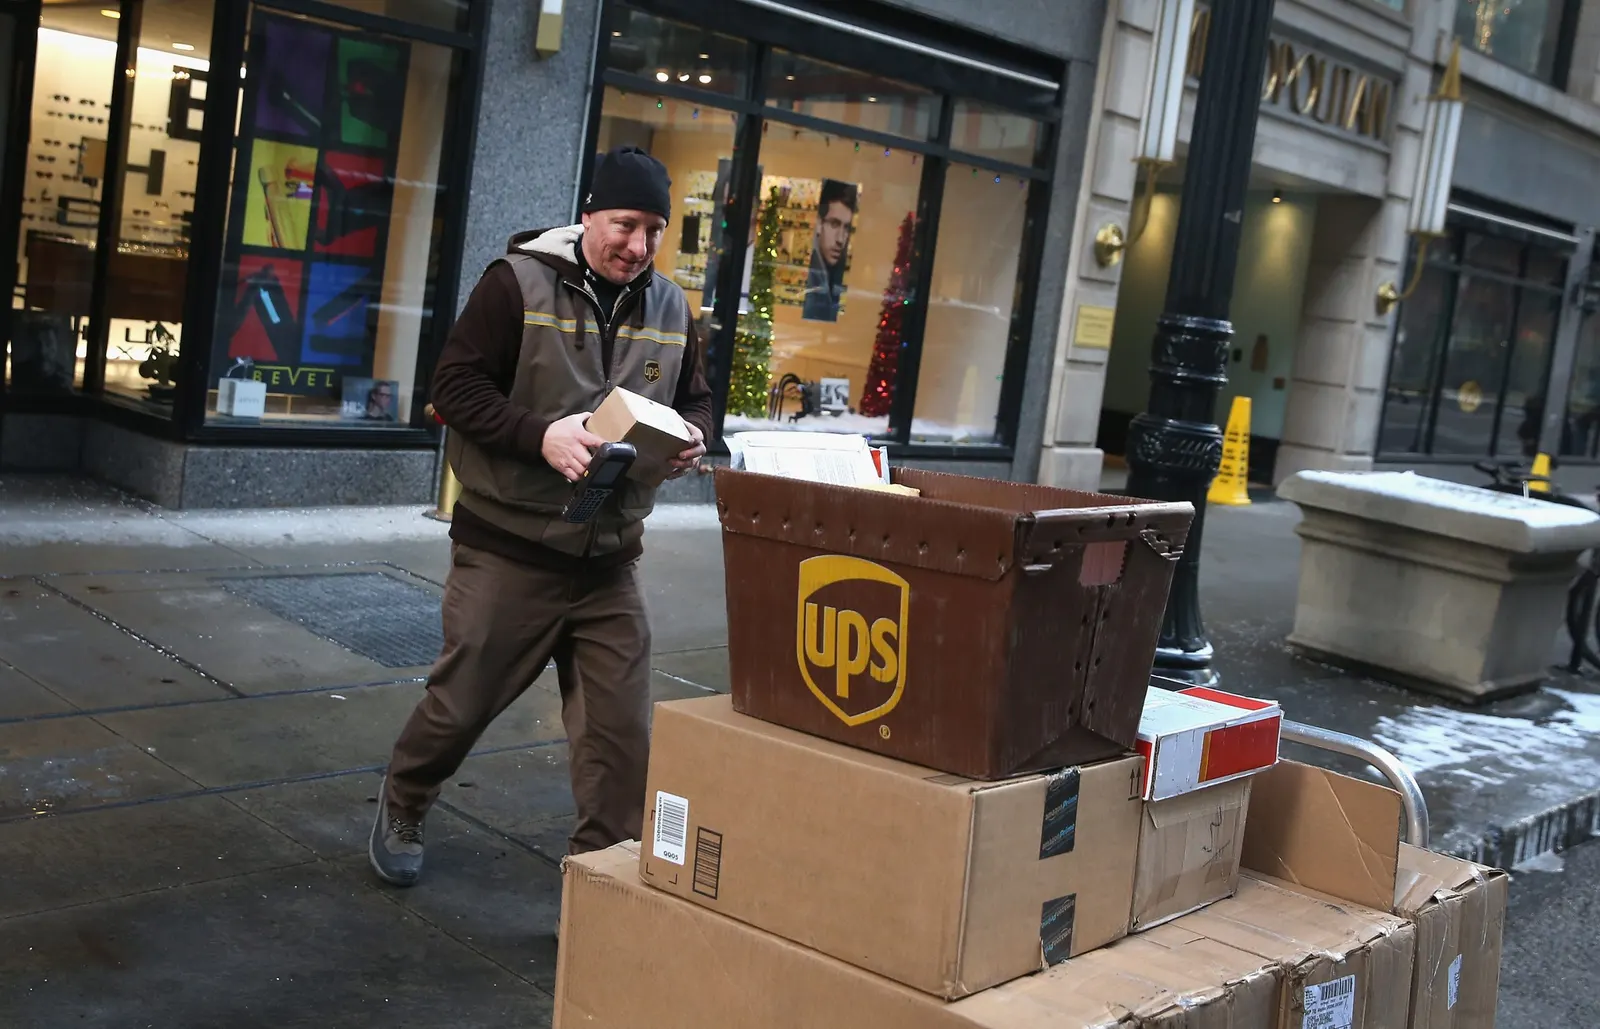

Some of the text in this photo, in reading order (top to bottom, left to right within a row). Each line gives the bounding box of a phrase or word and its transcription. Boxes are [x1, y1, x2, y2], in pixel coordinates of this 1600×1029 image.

[252, 366, 334, 388] BEVEL
[645, 366, 659, 380] ups
[805, 602, 898, 699] ups
